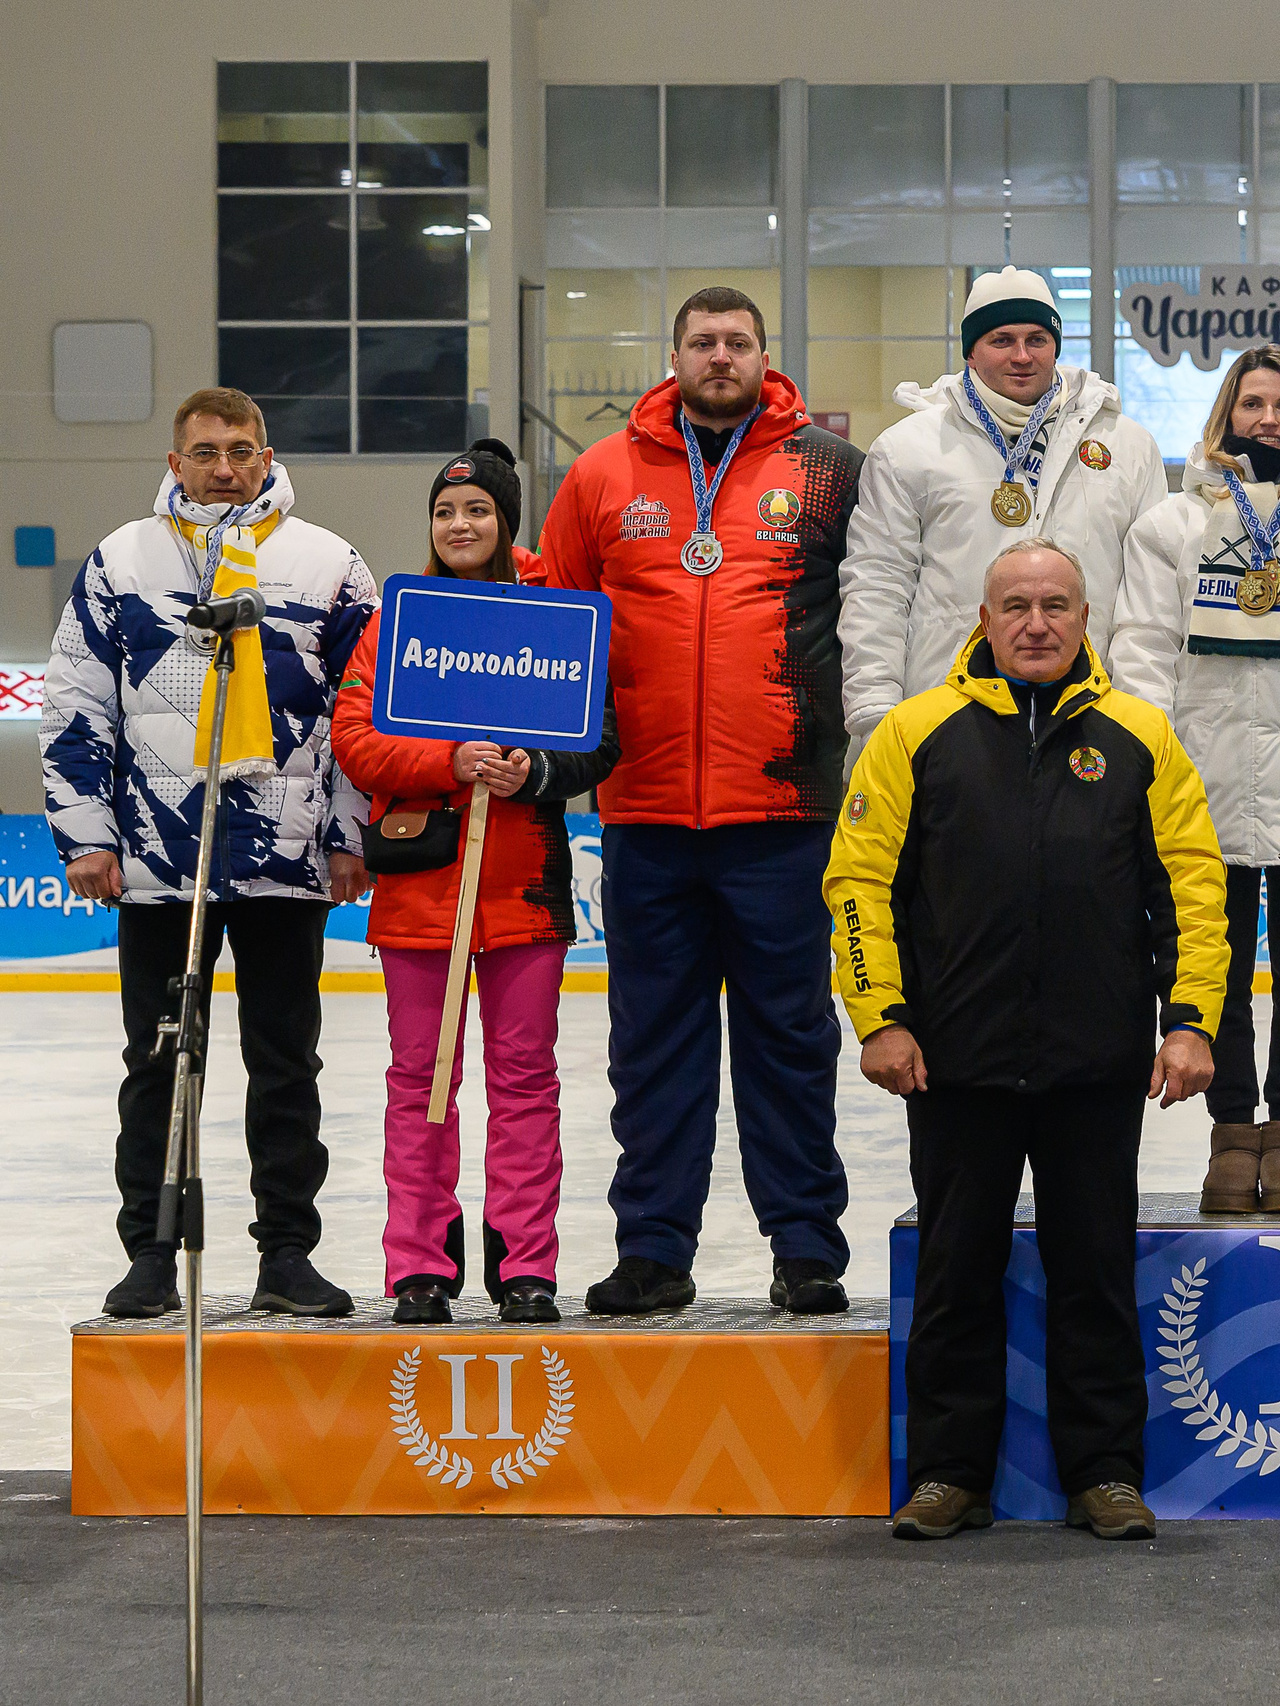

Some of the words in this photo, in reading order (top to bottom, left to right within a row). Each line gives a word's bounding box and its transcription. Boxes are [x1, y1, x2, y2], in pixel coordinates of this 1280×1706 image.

[620, 526, 670, 540] Пружаны
[622, 514, 669, 528] Щедрые
[756, 530, 799, 543] BELARUS
[402, 637, 583, 682] Агрохолдинг
[843, 898, 872, 993] BELARUS
[438, 1354, 525, 1440] II
